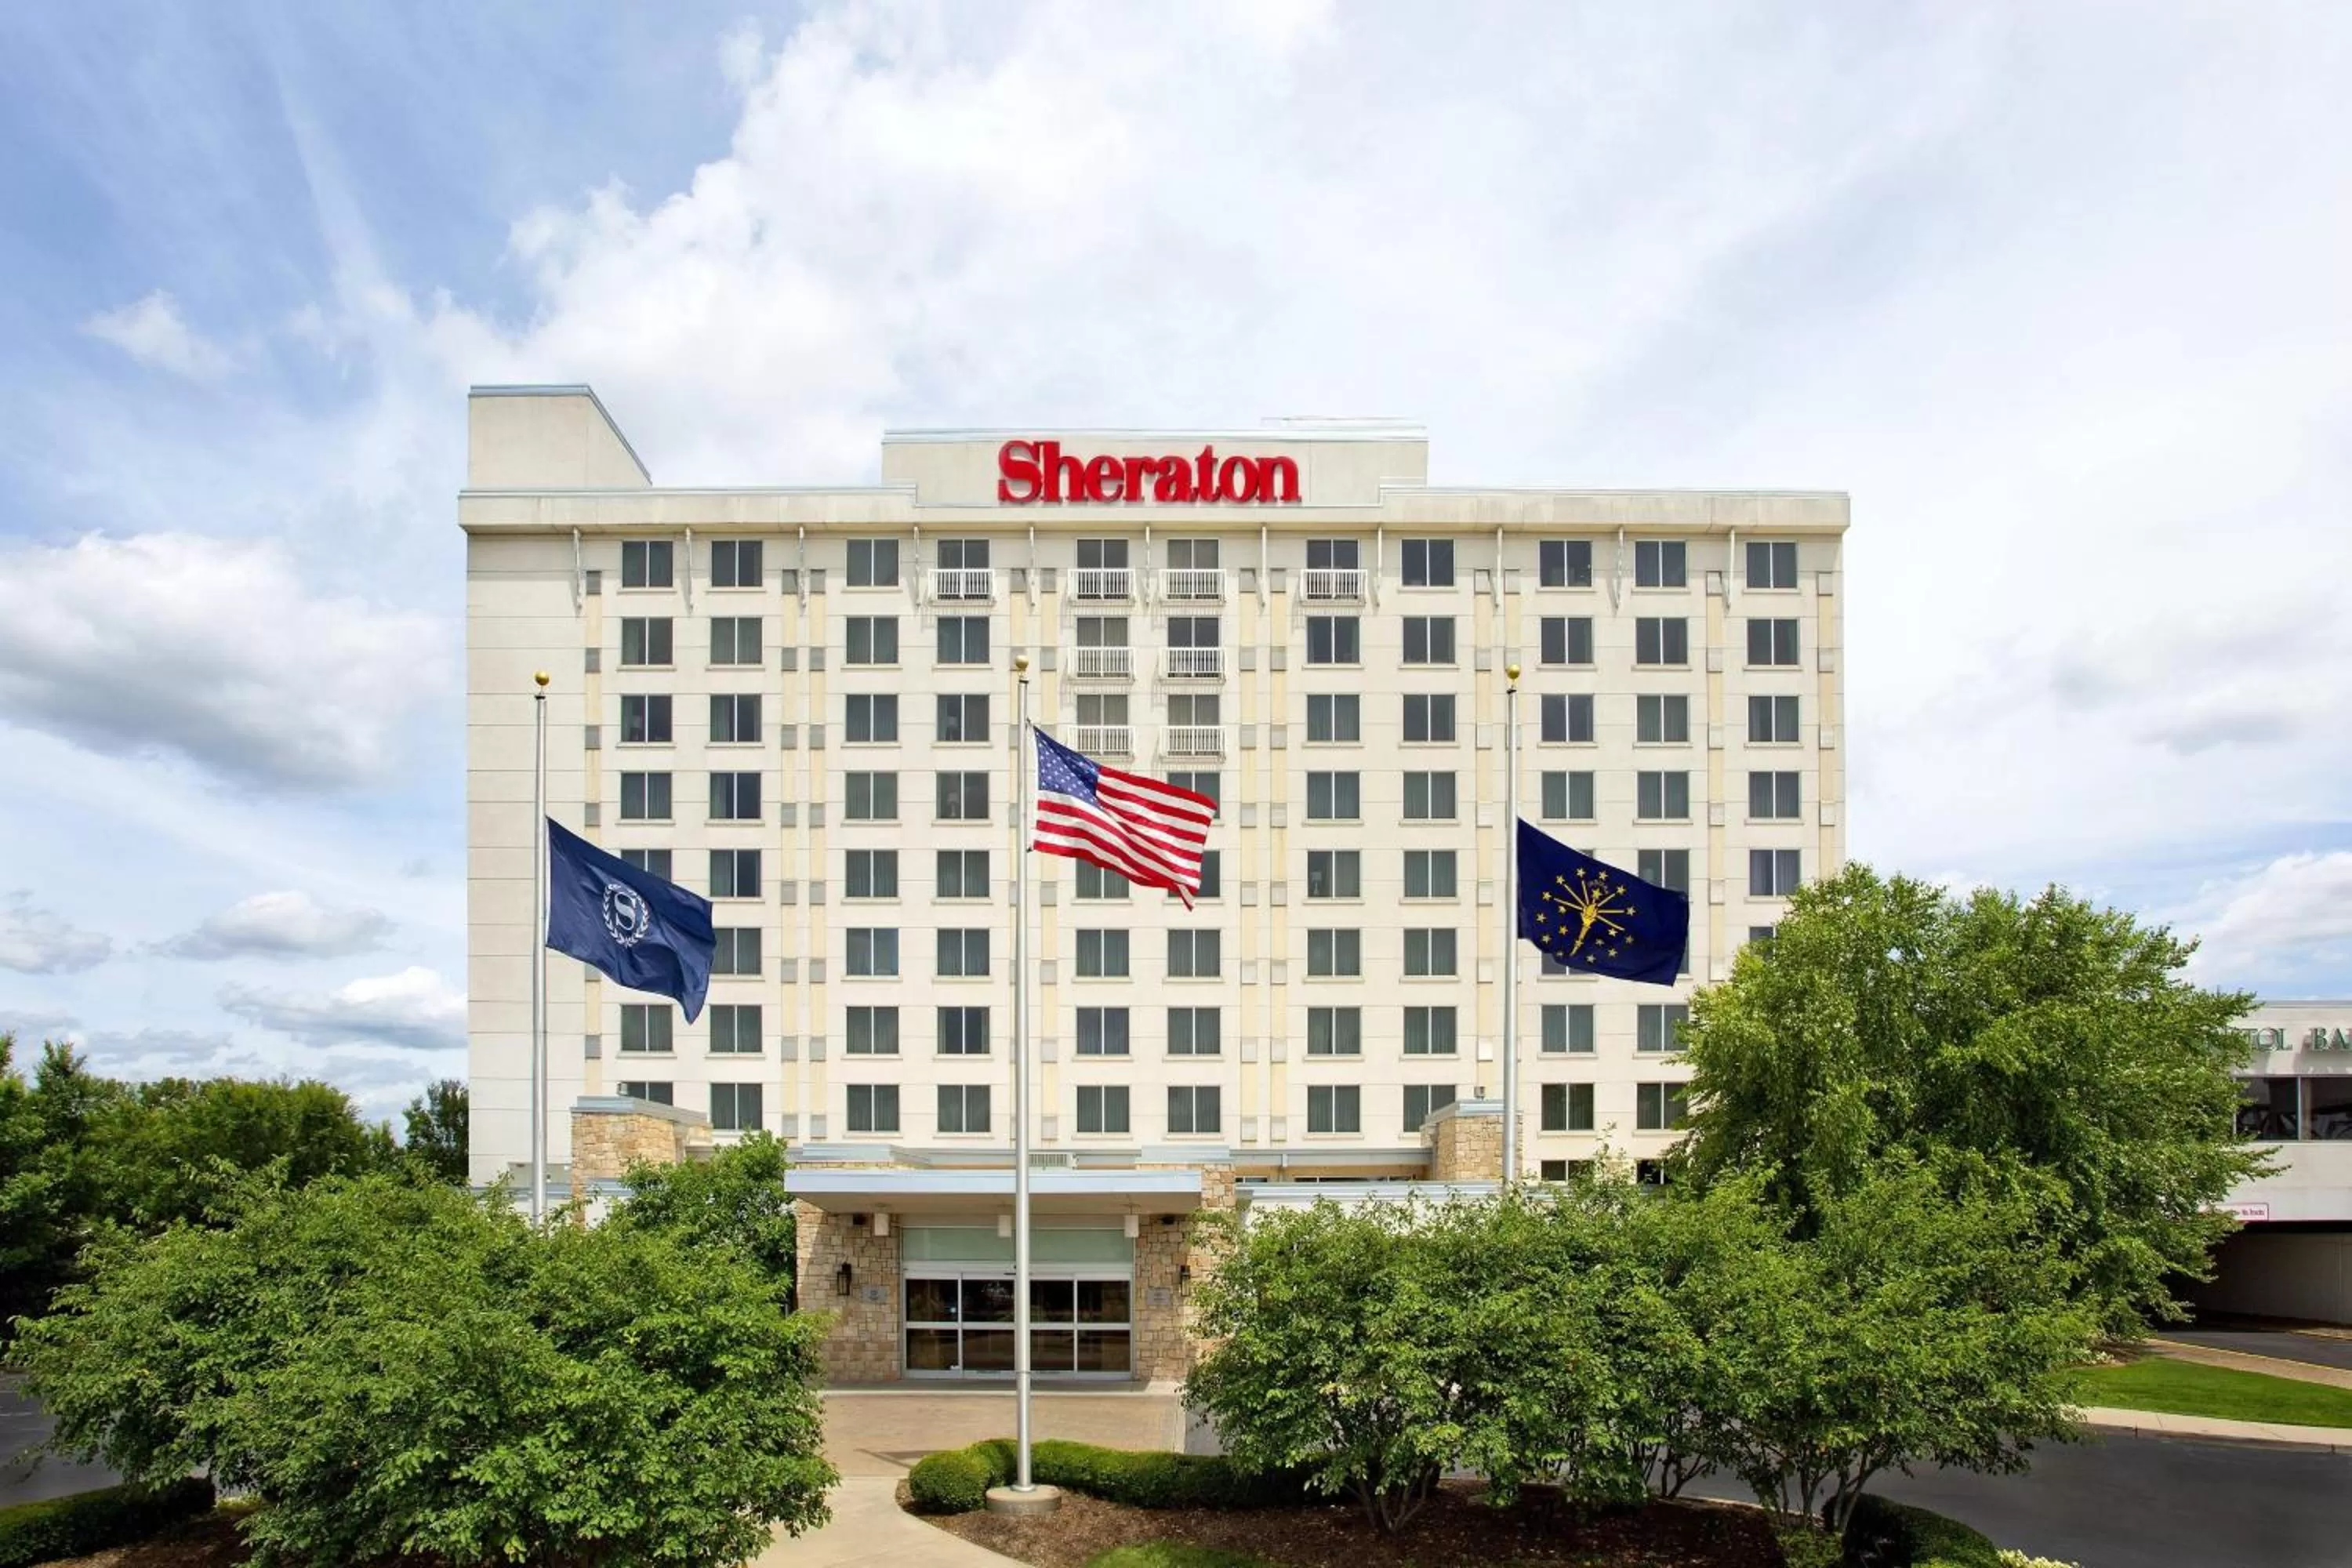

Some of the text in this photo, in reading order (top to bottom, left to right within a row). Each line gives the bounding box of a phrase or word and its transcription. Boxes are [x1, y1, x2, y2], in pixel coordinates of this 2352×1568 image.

[998, 440, 1301, 503] Sheraton
[614, 892, 637, 931] S
[2242, 1027, 2293, 1051] TOL
